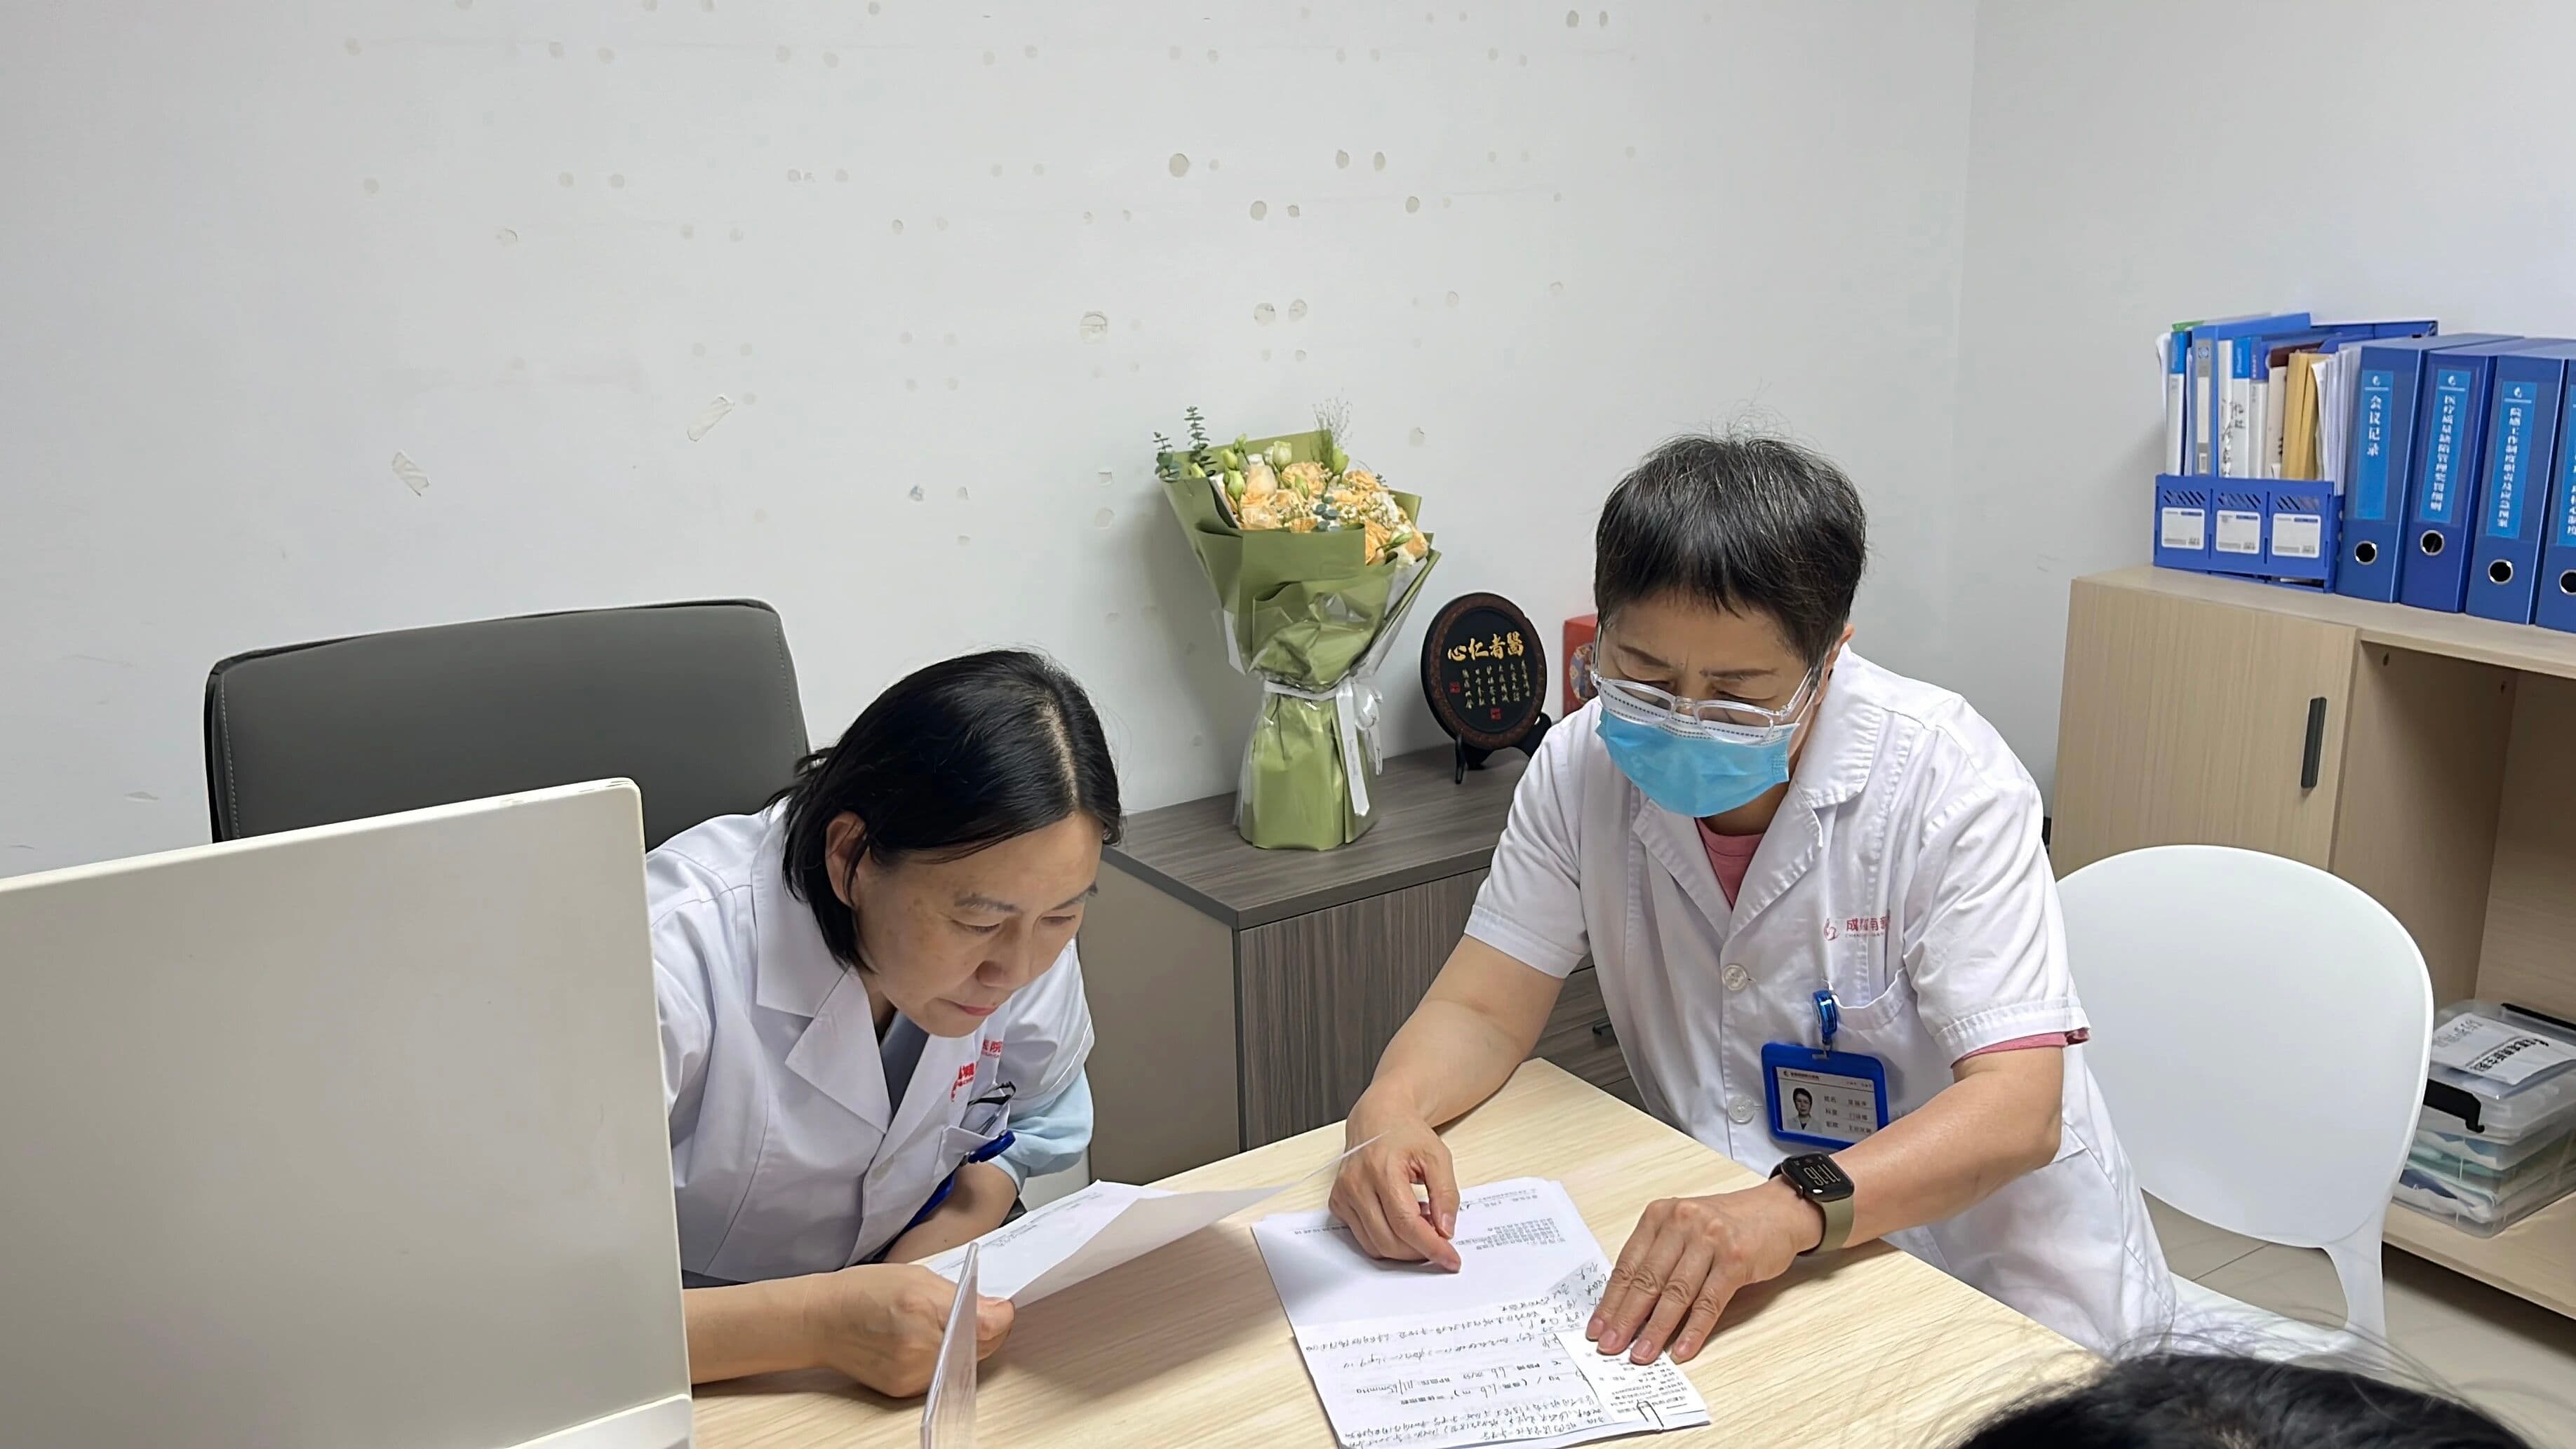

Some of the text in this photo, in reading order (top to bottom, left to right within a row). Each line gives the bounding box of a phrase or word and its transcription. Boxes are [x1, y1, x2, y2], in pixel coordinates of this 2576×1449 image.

[2367, 395, 2382, 457] 会议记录
[1804, 1164, 1841, 1186] 11:16
